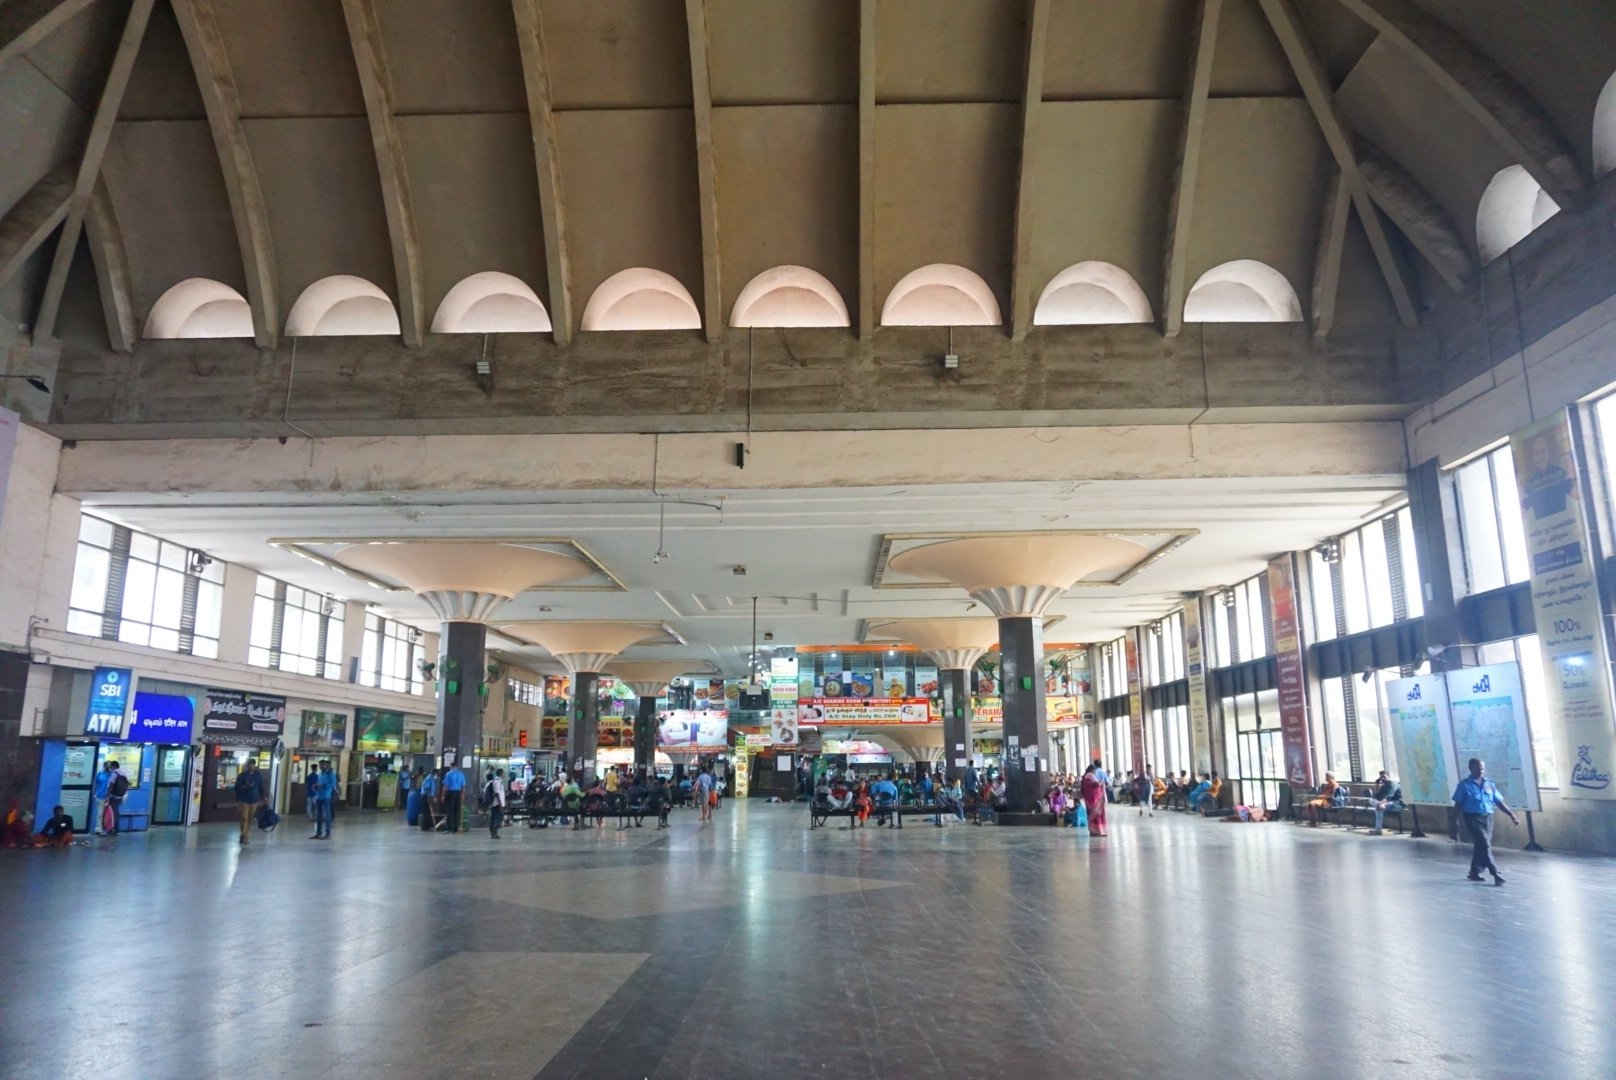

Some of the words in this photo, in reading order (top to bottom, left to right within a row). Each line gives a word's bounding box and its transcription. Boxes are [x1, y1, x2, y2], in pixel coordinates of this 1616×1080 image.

[1553, 617, 1581, 634] 100%
[99, 683, 122, 697] SBI
[87, 713, 123, 734] ATM
[177, 720, 188, 728] ATM
